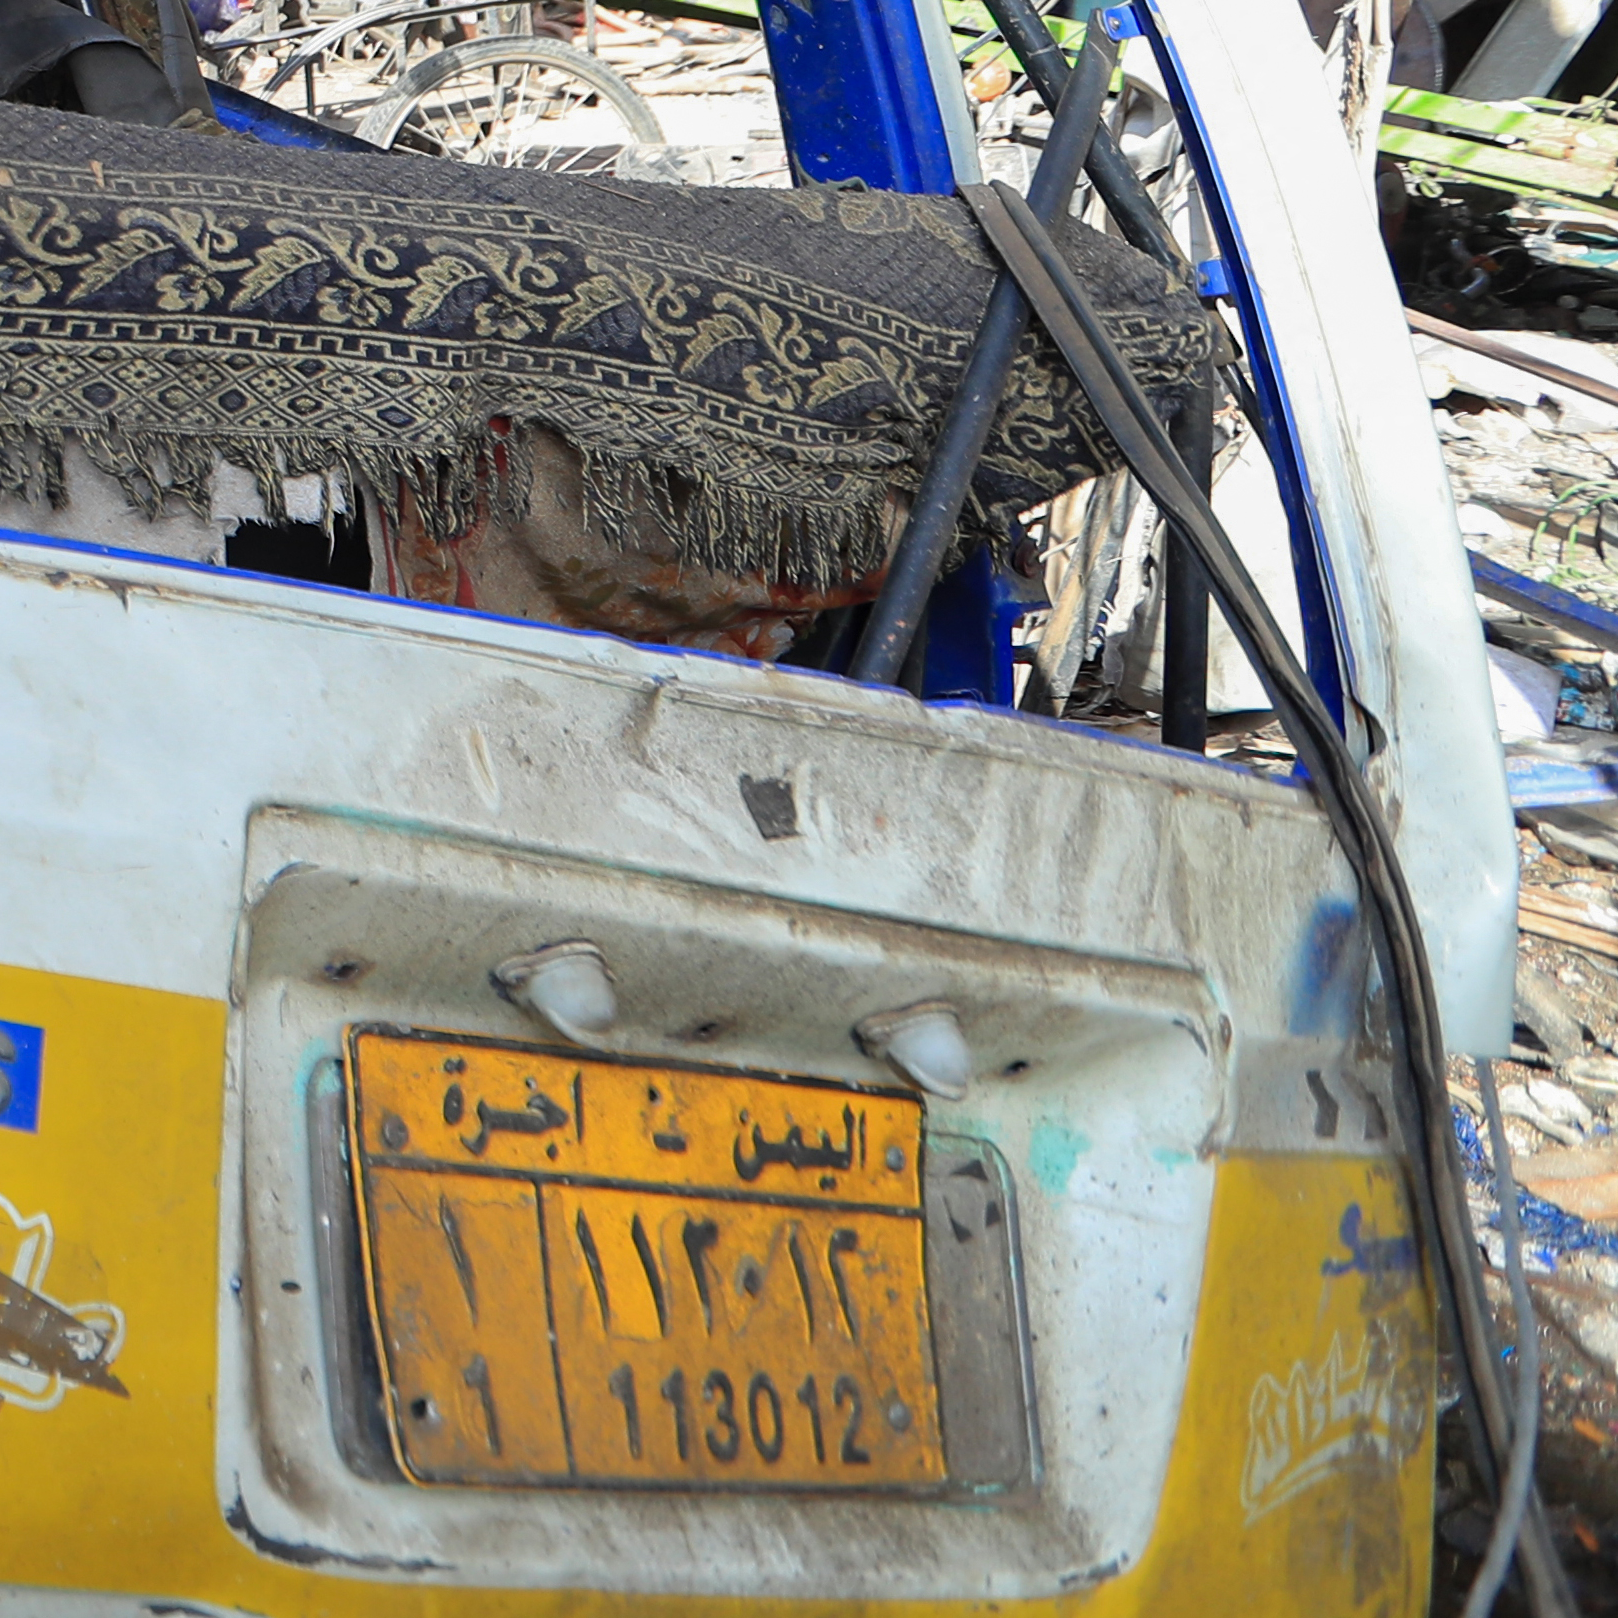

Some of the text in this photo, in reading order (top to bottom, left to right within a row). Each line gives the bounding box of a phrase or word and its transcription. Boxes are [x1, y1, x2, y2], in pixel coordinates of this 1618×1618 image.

[733, 1102, 869, 1190] اليمن
[463, 1352, 872, 1467] 1 113012
